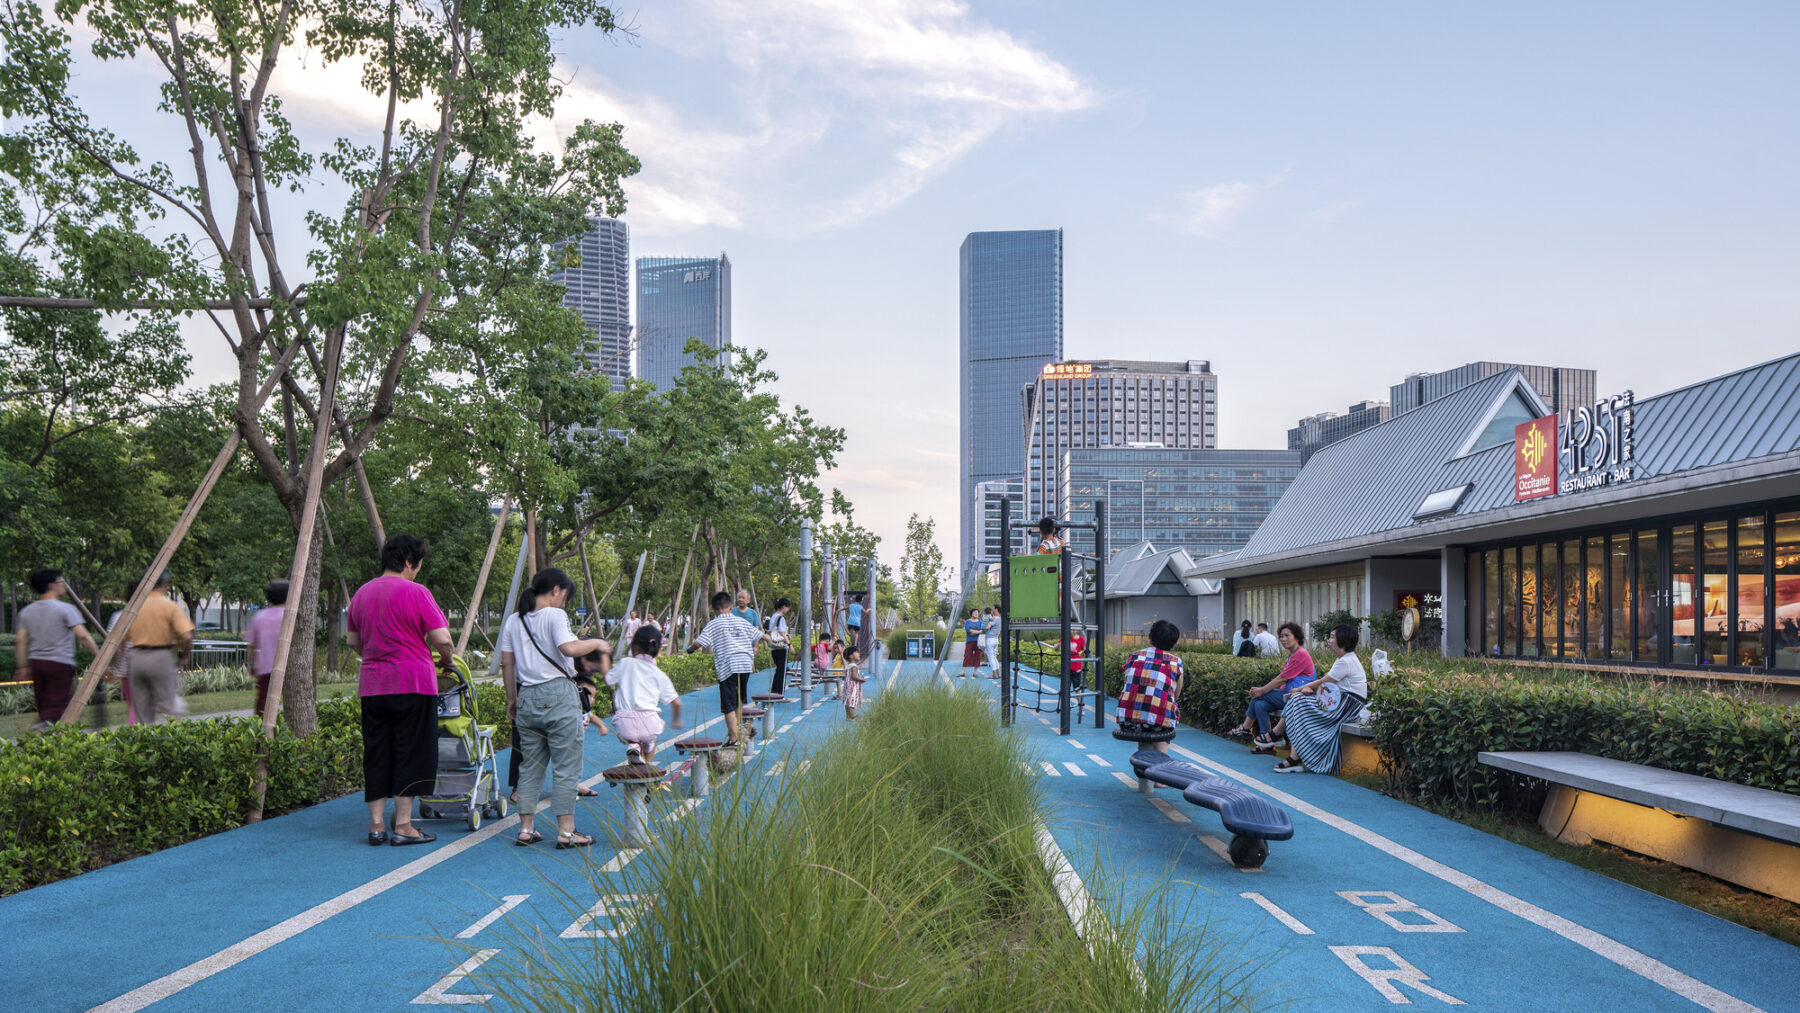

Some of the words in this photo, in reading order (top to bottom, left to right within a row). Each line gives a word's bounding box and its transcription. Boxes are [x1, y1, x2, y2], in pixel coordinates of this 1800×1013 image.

[1518, 475, 1550, 491] Occitanie
[1561, 471, 1607, 492] RESTAURANT
[1613, 467, 1631, 482] BAR
[408, 948, 503, 1005] L
[1326, 945, 1469, 1005] R
